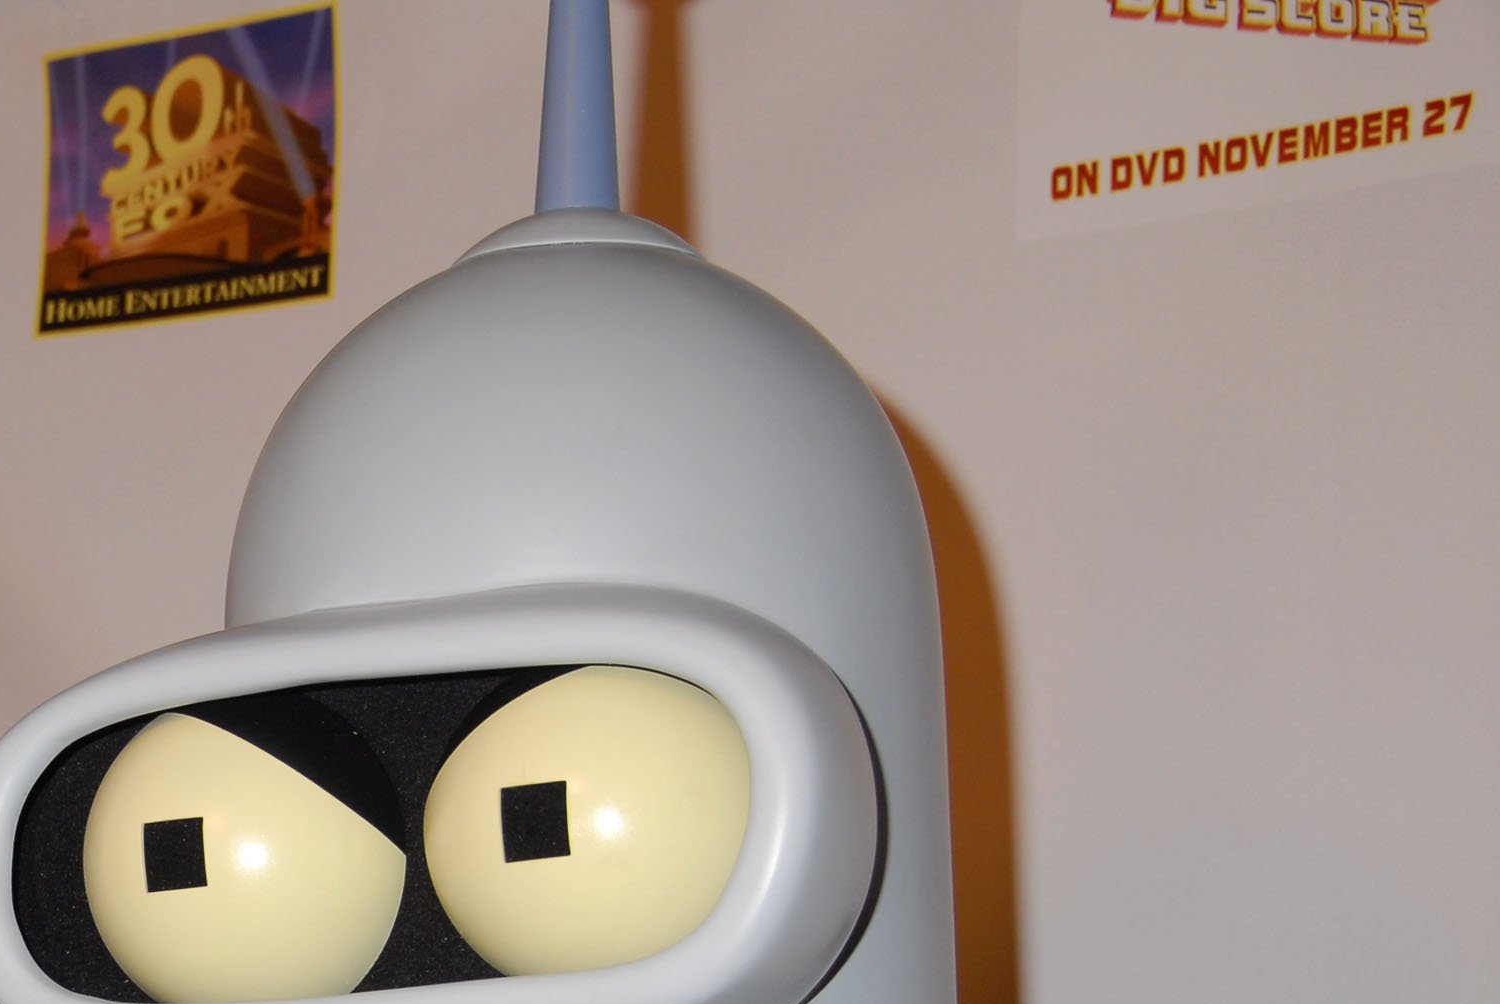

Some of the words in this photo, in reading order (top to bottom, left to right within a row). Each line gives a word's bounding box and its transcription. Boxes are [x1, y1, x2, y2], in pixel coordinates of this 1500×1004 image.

[1050, 159, 1099, 202] ON
[1109, 147, 1187, 193] DVD
[1197, 104, 1412, 179] NOVEMBER
[1421, 92, 1474, 138] 27
[45, 296, 122, 325] HOME
[124, 266, 325, 316] ENTERTAINMENT
